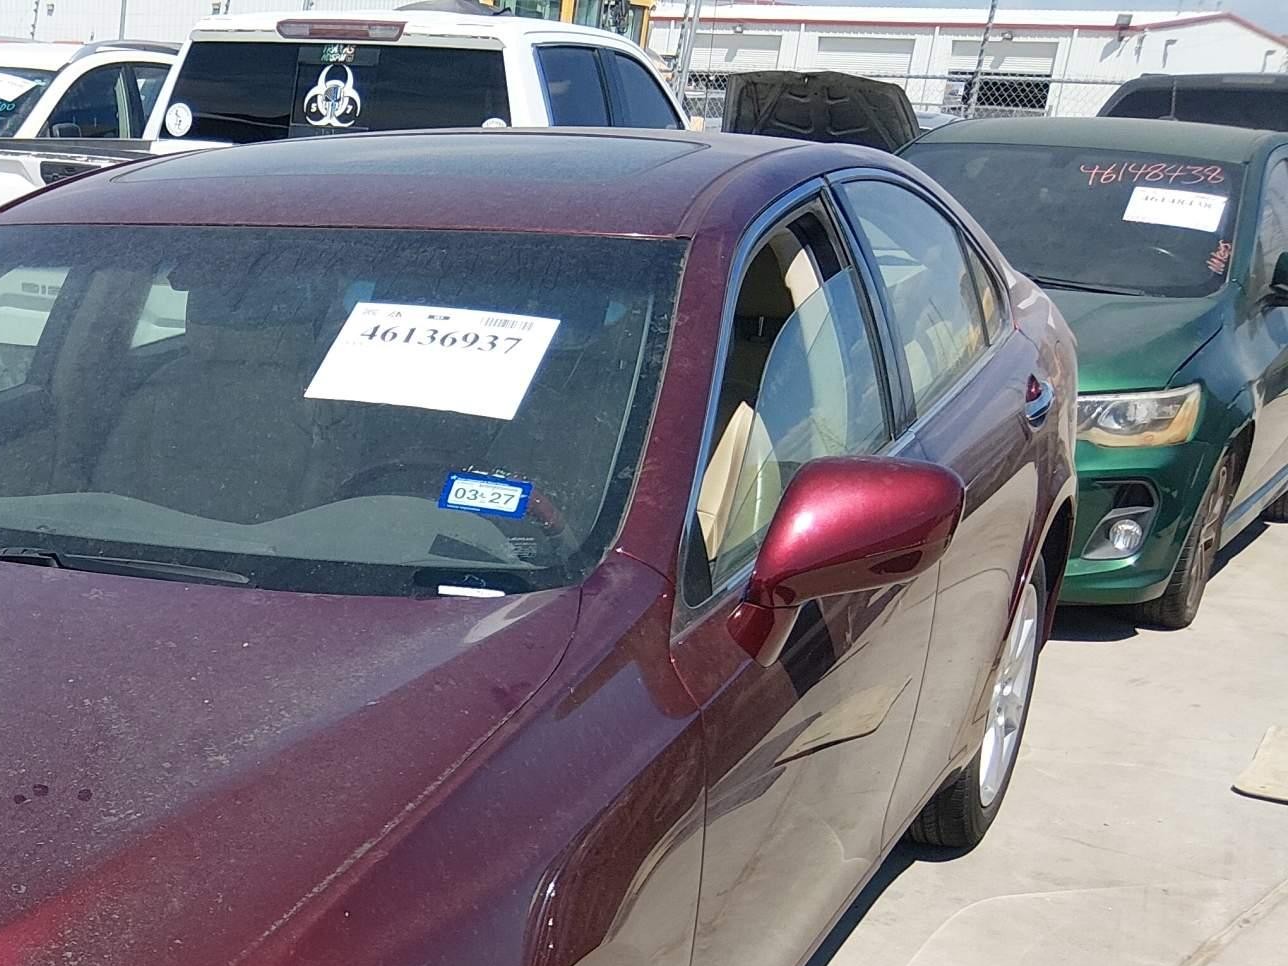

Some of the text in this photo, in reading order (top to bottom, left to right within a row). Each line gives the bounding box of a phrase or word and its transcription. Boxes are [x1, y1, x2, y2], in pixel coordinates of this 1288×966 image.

[1080, 162, 1225, 186] 46148438
[359, 324, 523, 354] 46136937
[454, 487, 515, 505] 03 27
